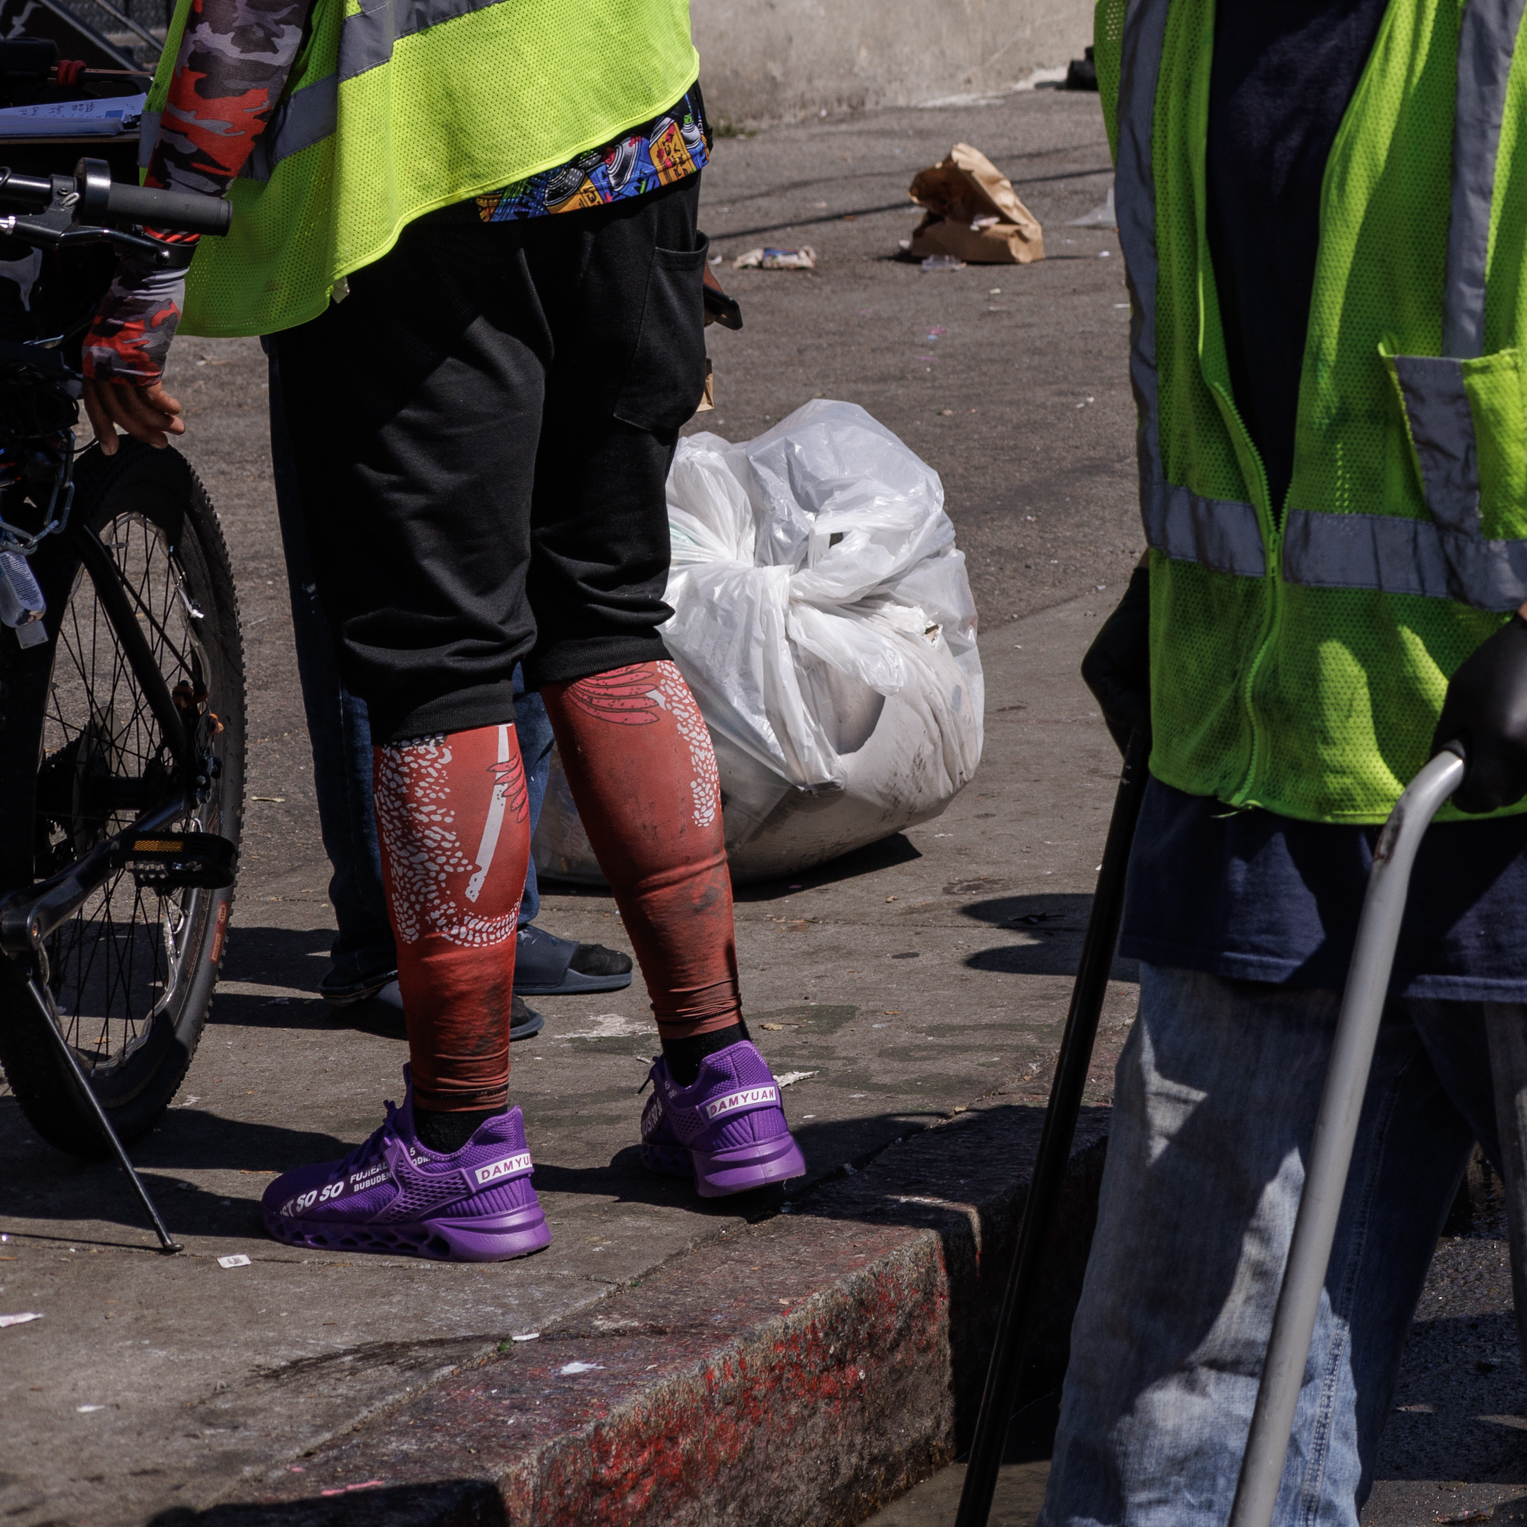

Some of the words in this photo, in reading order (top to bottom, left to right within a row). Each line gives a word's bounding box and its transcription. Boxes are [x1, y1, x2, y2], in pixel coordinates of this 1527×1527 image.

[711, 1088, 774, 1116] DAMYUAN
[296, 1190, 317, 1213] SO
[319, 1182, 344, 1202] SO
